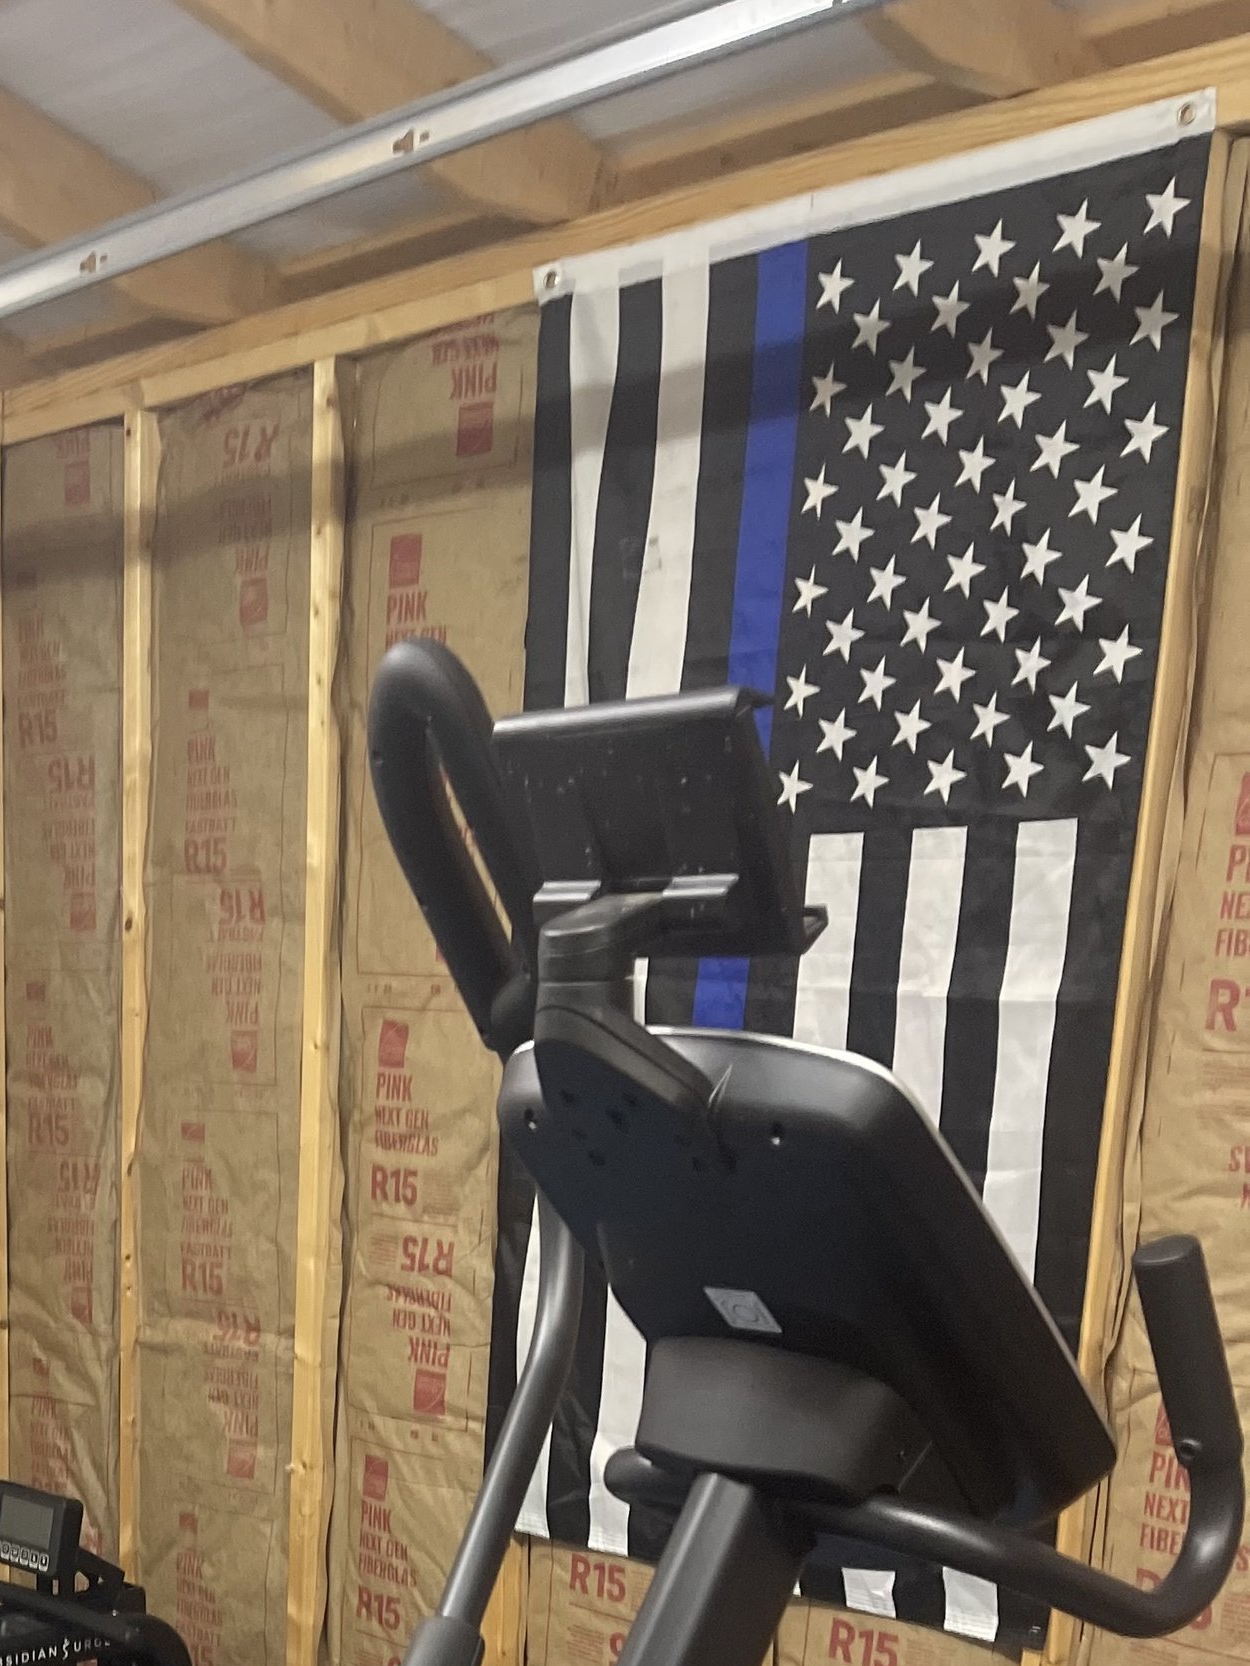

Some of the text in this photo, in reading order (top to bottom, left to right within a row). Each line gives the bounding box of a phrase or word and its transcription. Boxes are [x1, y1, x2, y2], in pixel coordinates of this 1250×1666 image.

[451, 361, 498, 400] PINK
[386, 590, 428, 626] PINK
[18, 711, 58, 748] R15
[48, 753, 95, 793] R15
[184, 835, 228, 875] R15
[219, 884, 266, 927] R15
[226, 1000, 259, 1027] PINK
[376, 1072, 413, 1101] PINK
[375, 1105, 430, 1131] NEXT GEN
[375, 1129, 439, 1157] FIBERGLAS
[181, 1165, 213, 1192] PINK
[371, 1162, 418, 1206] R15
[401, 1234, 455, 1278] R15
[181, 1257, 224, 1297] R15
[392, 1307, 451, 1338] NEXT GEN
[408, 1335, 451, 1369] PINK
[222, 1410, 259, 1440] PINK
[1149, 1451, 1191, 1492] PIN
[361, 1501, 392, 1535] PINK
[1144, 1491, 1190, 1526] NEXT
[359, 1531, 409, 1563] NEXT GEN
[175, 1551, 203, 1581] PINK
[358, 1552, 418, 1588] FIBERGLAS
[569, 1552, 626, 1603] R15
[356, 1584, 401, 1631] R15
